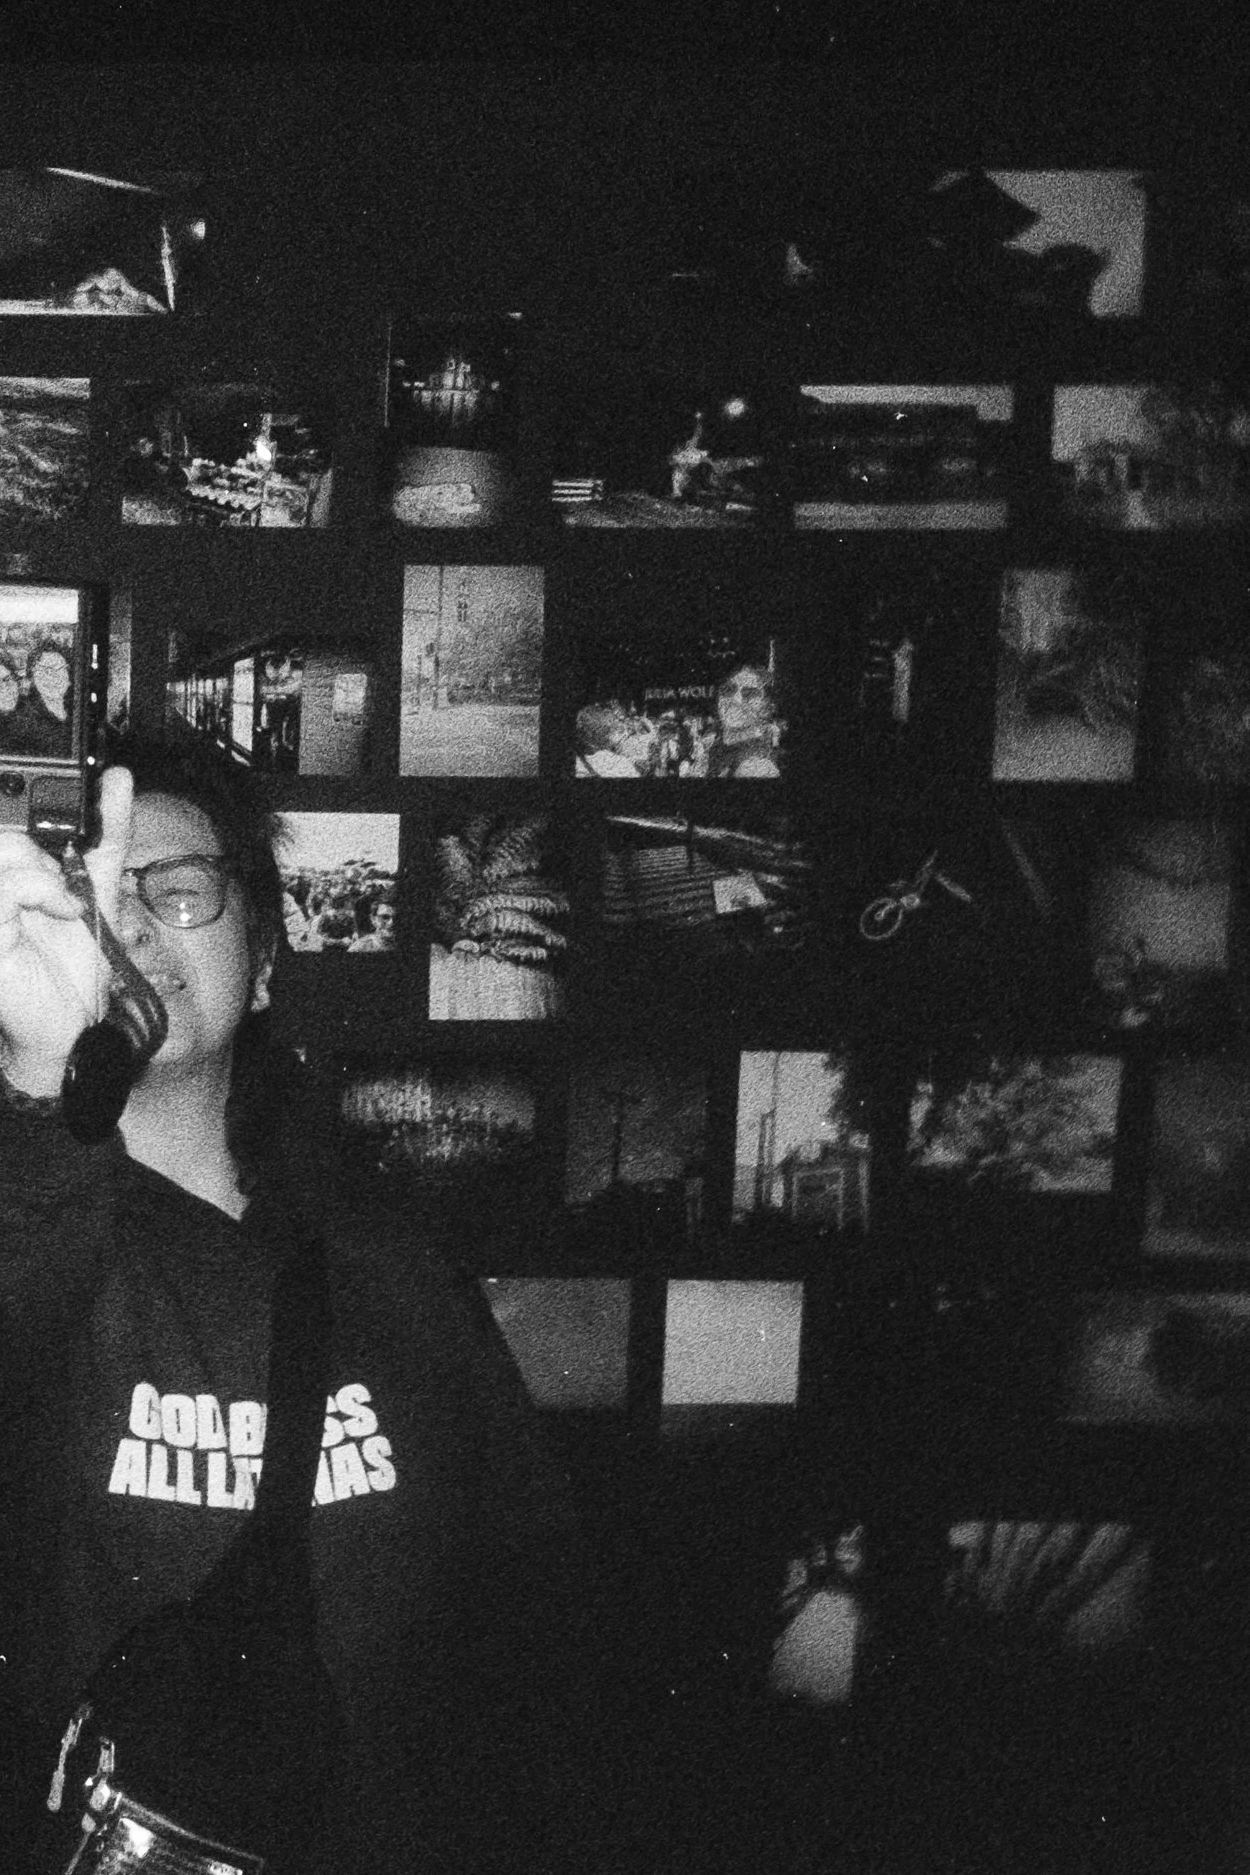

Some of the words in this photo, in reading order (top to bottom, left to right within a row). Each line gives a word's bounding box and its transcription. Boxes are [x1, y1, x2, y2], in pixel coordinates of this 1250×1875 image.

[129, 1381, 228, 1449] GOD
[229, 1382, 378, 1456] BSS
[108, 1438, 202, 1505] ALL
[207, 1435, 397, 1511] LANAS
